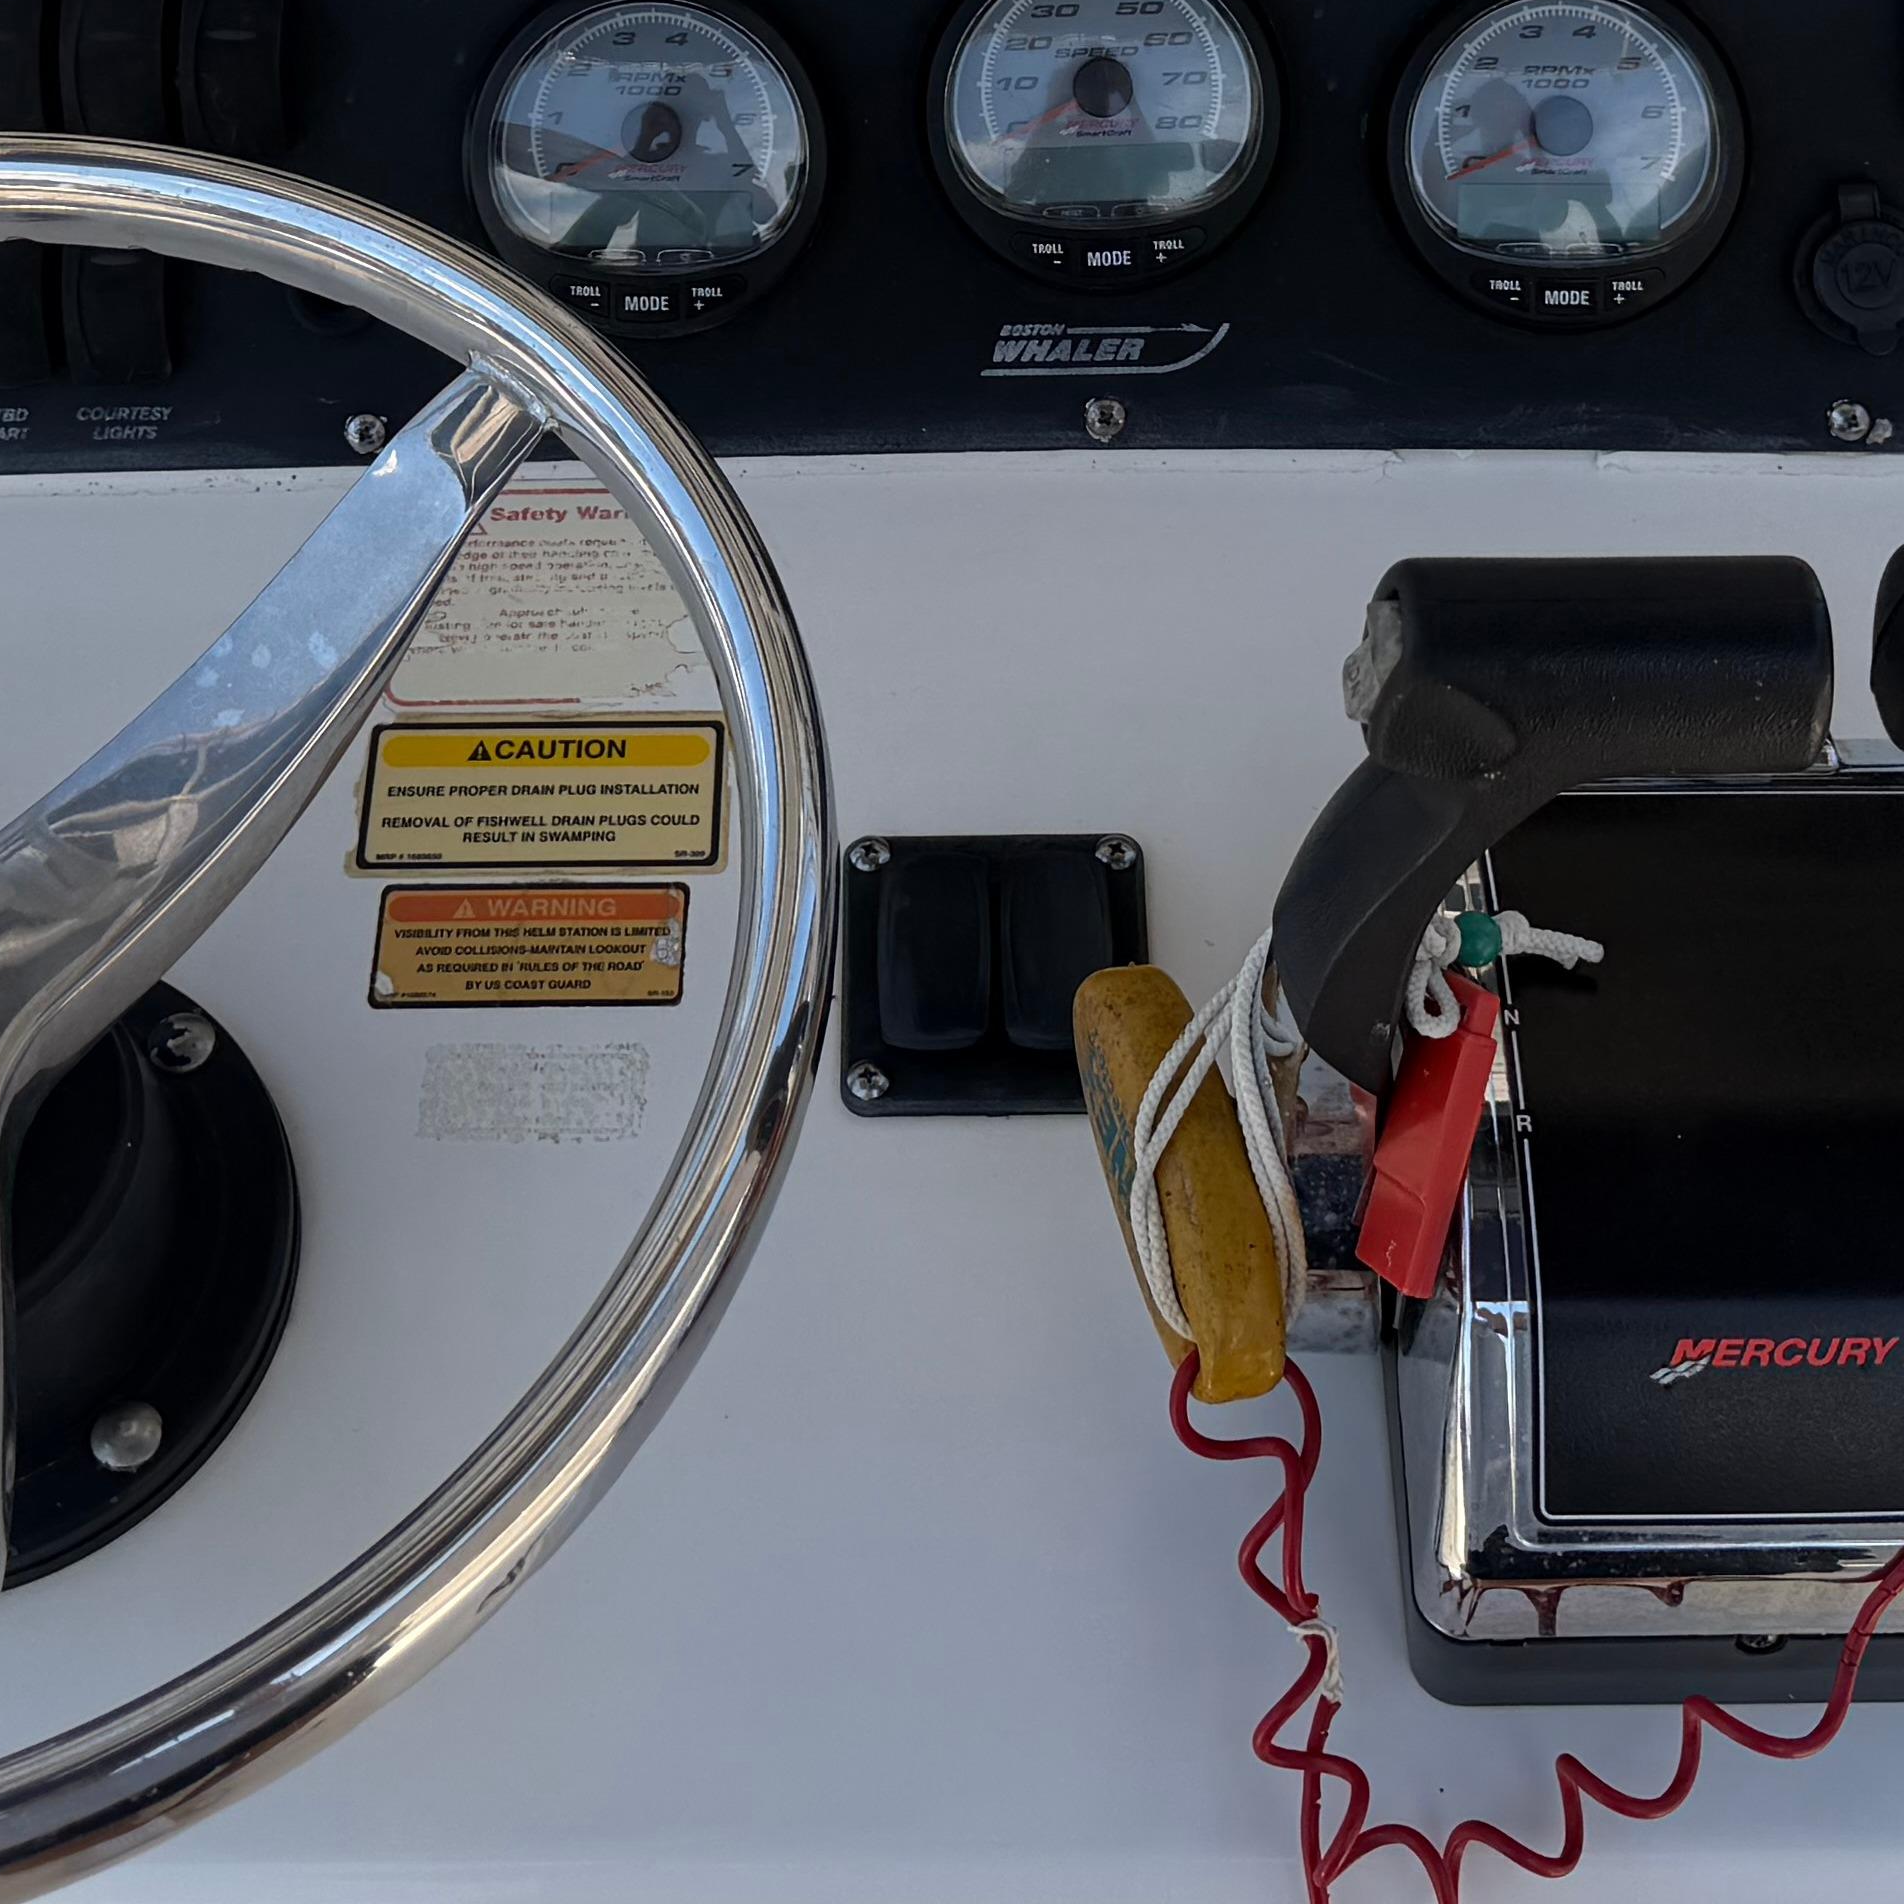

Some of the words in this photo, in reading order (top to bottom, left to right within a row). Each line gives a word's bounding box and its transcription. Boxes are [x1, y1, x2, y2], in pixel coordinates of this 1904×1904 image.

[1031, 3, 1080, 18] 30
[1115, 0, 1165, 15] 50
[612, 31, 636, 46] 3
[665, 31, 689, 46] 4
[1518, 25, 1544, 40] 3
[1572, 24, 1598, 39] 4
[1004, 36, 1053, 52] 20
[1143, 32, 1194, 47] 60
[1054, 46, 1140, 59] SPEED
[1473, 56, 1500, 71] 2
[996, 76, 1040, 91] 10
[1162, 71, 1210, 87] 70
[1154, 116, 1203, 130] 80
[1031, 243, 1064, 255] TROLL
[1152, 239, 1185, 251] TROLL
[1087, 250, 1132, 266] MODE
[570, 285, 601, 297] TROLL
[691, 286, 723, 298] TROLL
[1489, 279, 1522, 291] TROLL
[1612, 280, 1645, 292] TROLL
[624, 296, 670, 311] MODE
[1545, 290, 1590, 305] MODE
[999, 323, 1067, 337] BOSTON
[992, 337, 1146, 364] WHALER
[75, 405, 173, 421] COURTESY
[93, 424, 158, 440] LIGHTS
[490, 506, 568, 524] Safety
[495, 739, 627, 761] CAUTION
[387, 785, 445, 798] ENSURE
[449, 784, 507, 797] PROPER
[511, 784, 555, 796] DRAIN
[558, 784, 596, 796] PLUG
[600, 783, 700, 796] INSTALLATION
[381, 816, 450, 829] REMOVAL
[454, 816, 474, 828] OF
[477, 815, 546, 828] FISHWELL
[551, 815, 595, 827] DRAIN
[598, 814, 647, 827] PLUGS
[650, 814, 700, 826] COULD
[462, 831, 517, 843] RESULT
[521, 831, 536, 843] IN
[539, 830, 616, 843] SWAMPING
[488, 898, 617, 918] WARNING
[394, 928, 453, 939] VISIBILITY
[456, 928, 491, 938] FROM
[494, 928, 520, 938] THIS
[523, 927, 556, 938] HELM
[559, 927, 607, 937] STATION
[610, 927, 621, 937] IS
[624, 927, 671, 937] LIMITED
[415, 946, 452, 957] AVOID
[589, 944, 647, 955] LOOKOUT
[416, 963, 433, 973] AS
[436, 962, 498, 973] REQUIRED
[501, 962, 513, 972] IN
[562, 962, 579, 972] OF
[582, 961, 604, 972] THE
[465, 980, 481, 991] BY
[484, 980, 501, 990] US
[504, 980, 546, 990] COAST
[548, 979, 592, 990] GUARD
[1503, 1008, 1520, 1026] N
[1516, 1114, 1533, 1133] R
[1670, 1336, 1900, 1369] MERCURY
